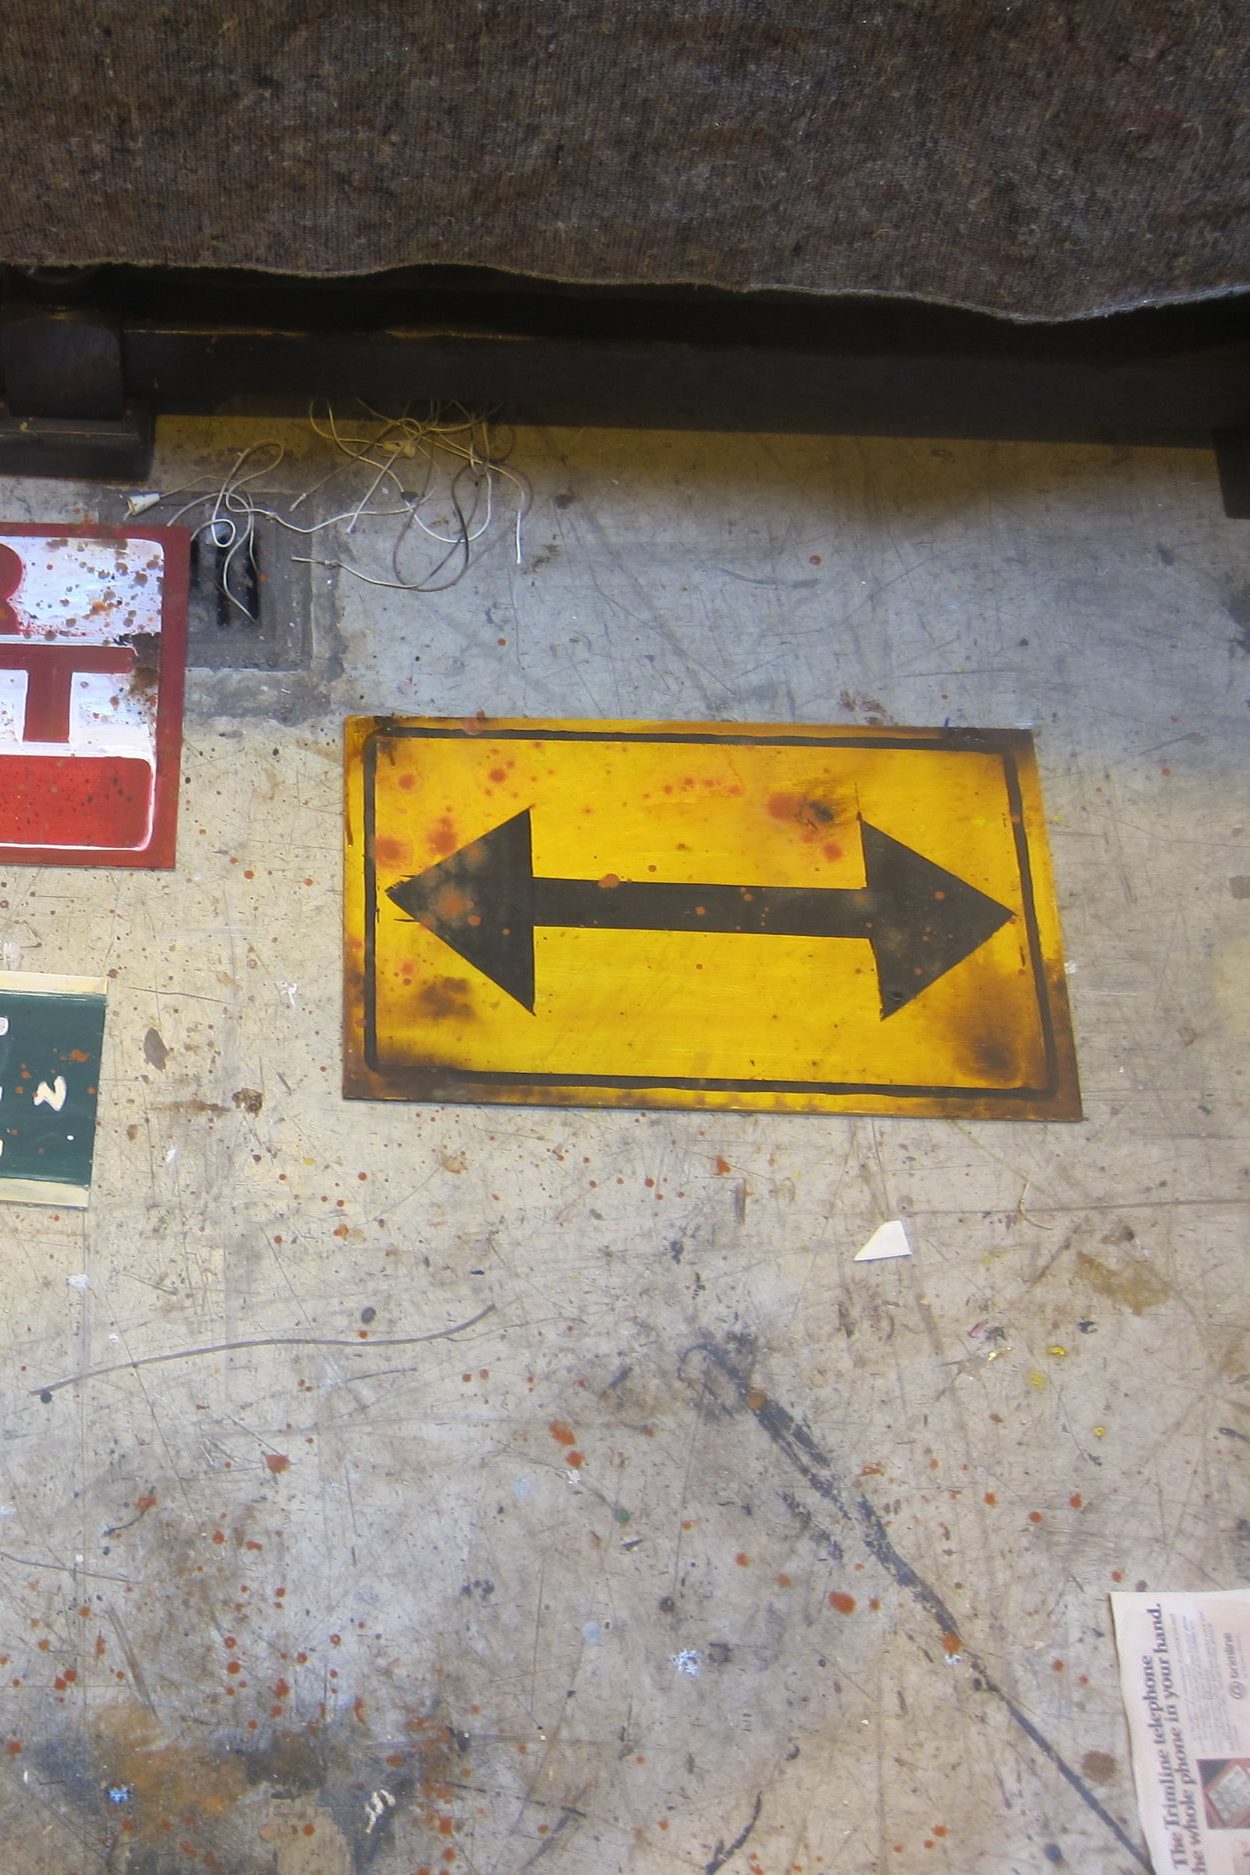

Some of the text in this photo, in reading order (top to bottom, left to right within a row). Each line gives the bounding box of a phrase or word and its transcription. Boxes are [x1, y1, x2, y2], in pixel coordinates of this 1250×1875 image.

[1142, 1655, 1189, 1870] The Trimline telephone
[1146, 1603, 1206, 1875] he whole phone in your hand.
